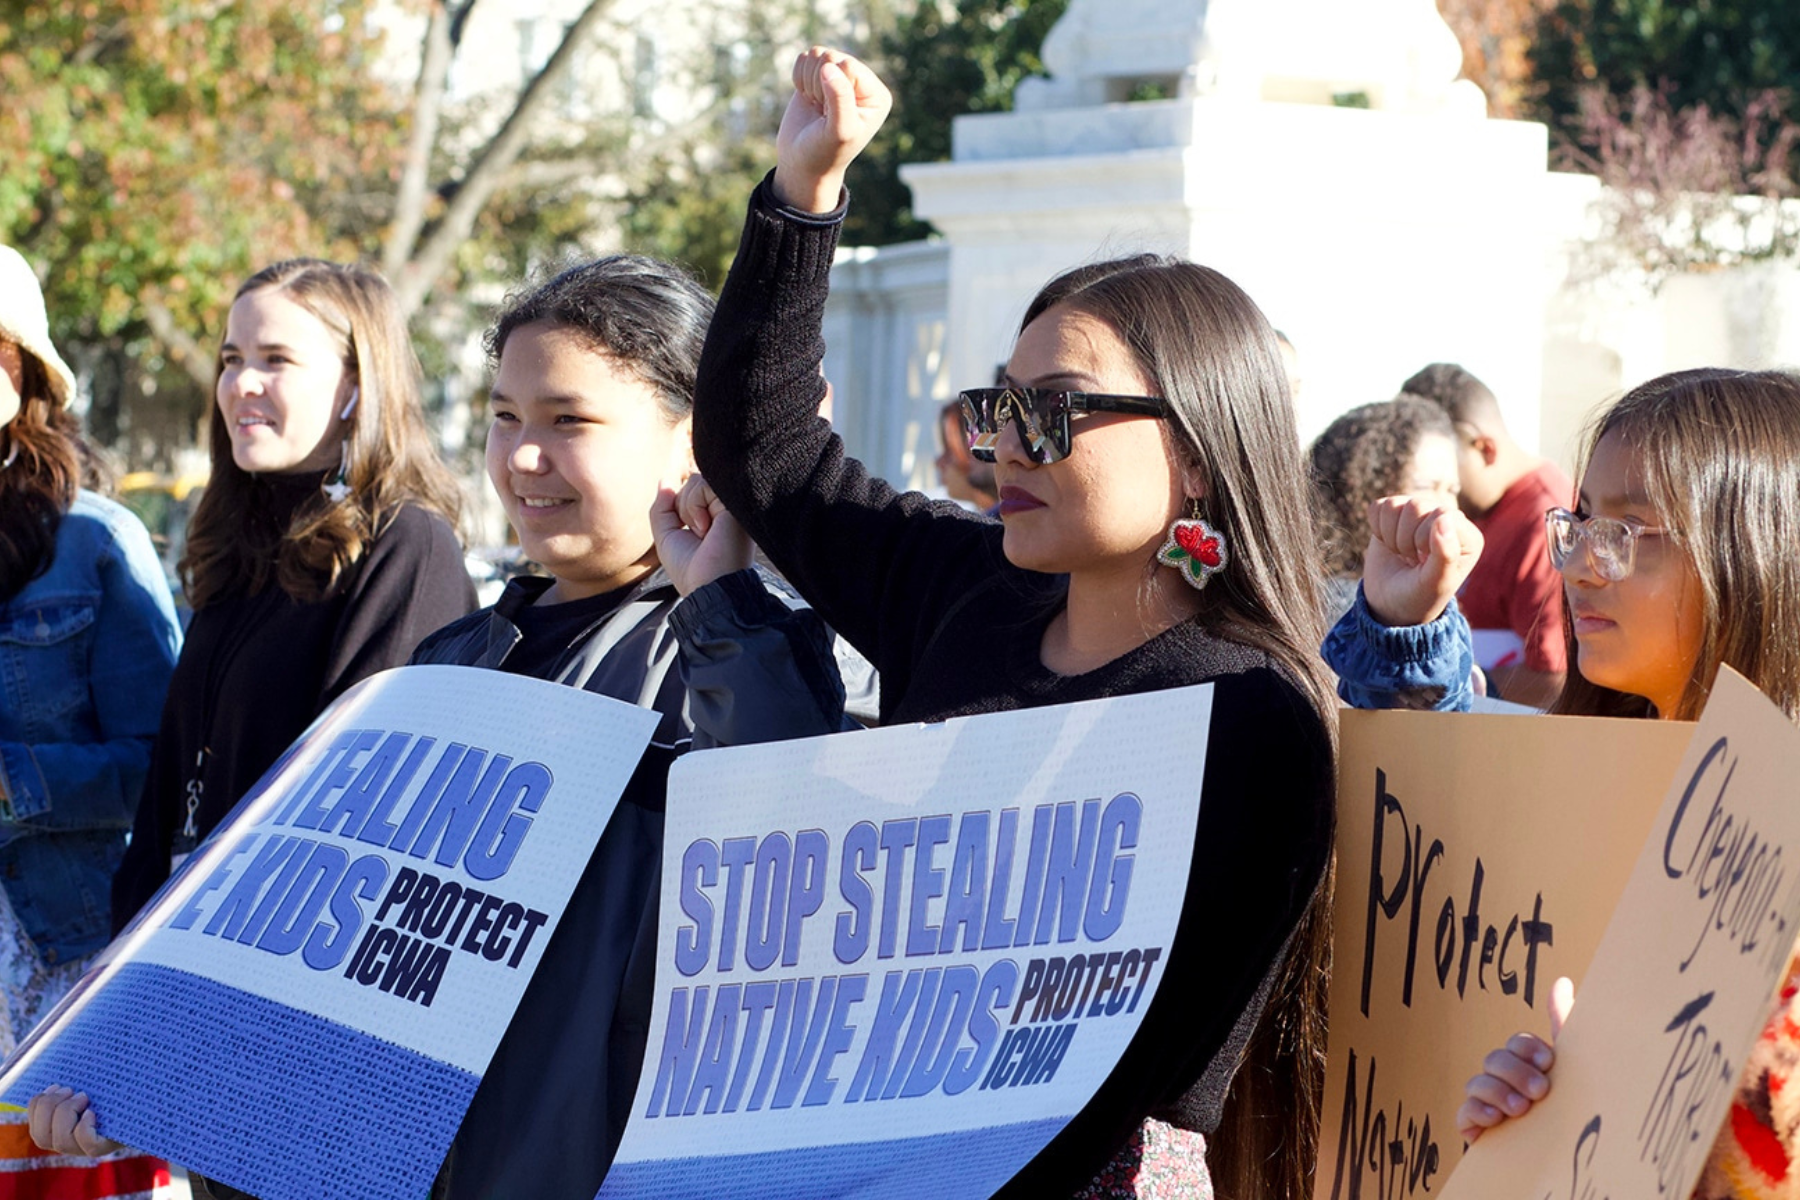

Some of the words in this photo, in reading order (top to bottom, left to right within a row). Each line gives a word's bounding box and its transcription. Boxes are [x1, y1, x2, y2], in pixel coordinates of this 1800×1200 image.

[250, 729, 554, 881] TEALING
[200, 834, 390, 971] KIDS
[374, 866, 548, 969] PROTECT
[674, 828, 830, 977] STOP
[832, 791, 1143, 964] STEALING
[1360, 766, 1554, 1018] Protect
[343, 923, 452, 1008] ICWA
[1009, 946, 1163, 1026] PROTECT
[645, 974, 867, 1118] NATIVE
[843, 957, 1019, 1104] KIDS
[978, 1022, 1077, 1092] ICWA
